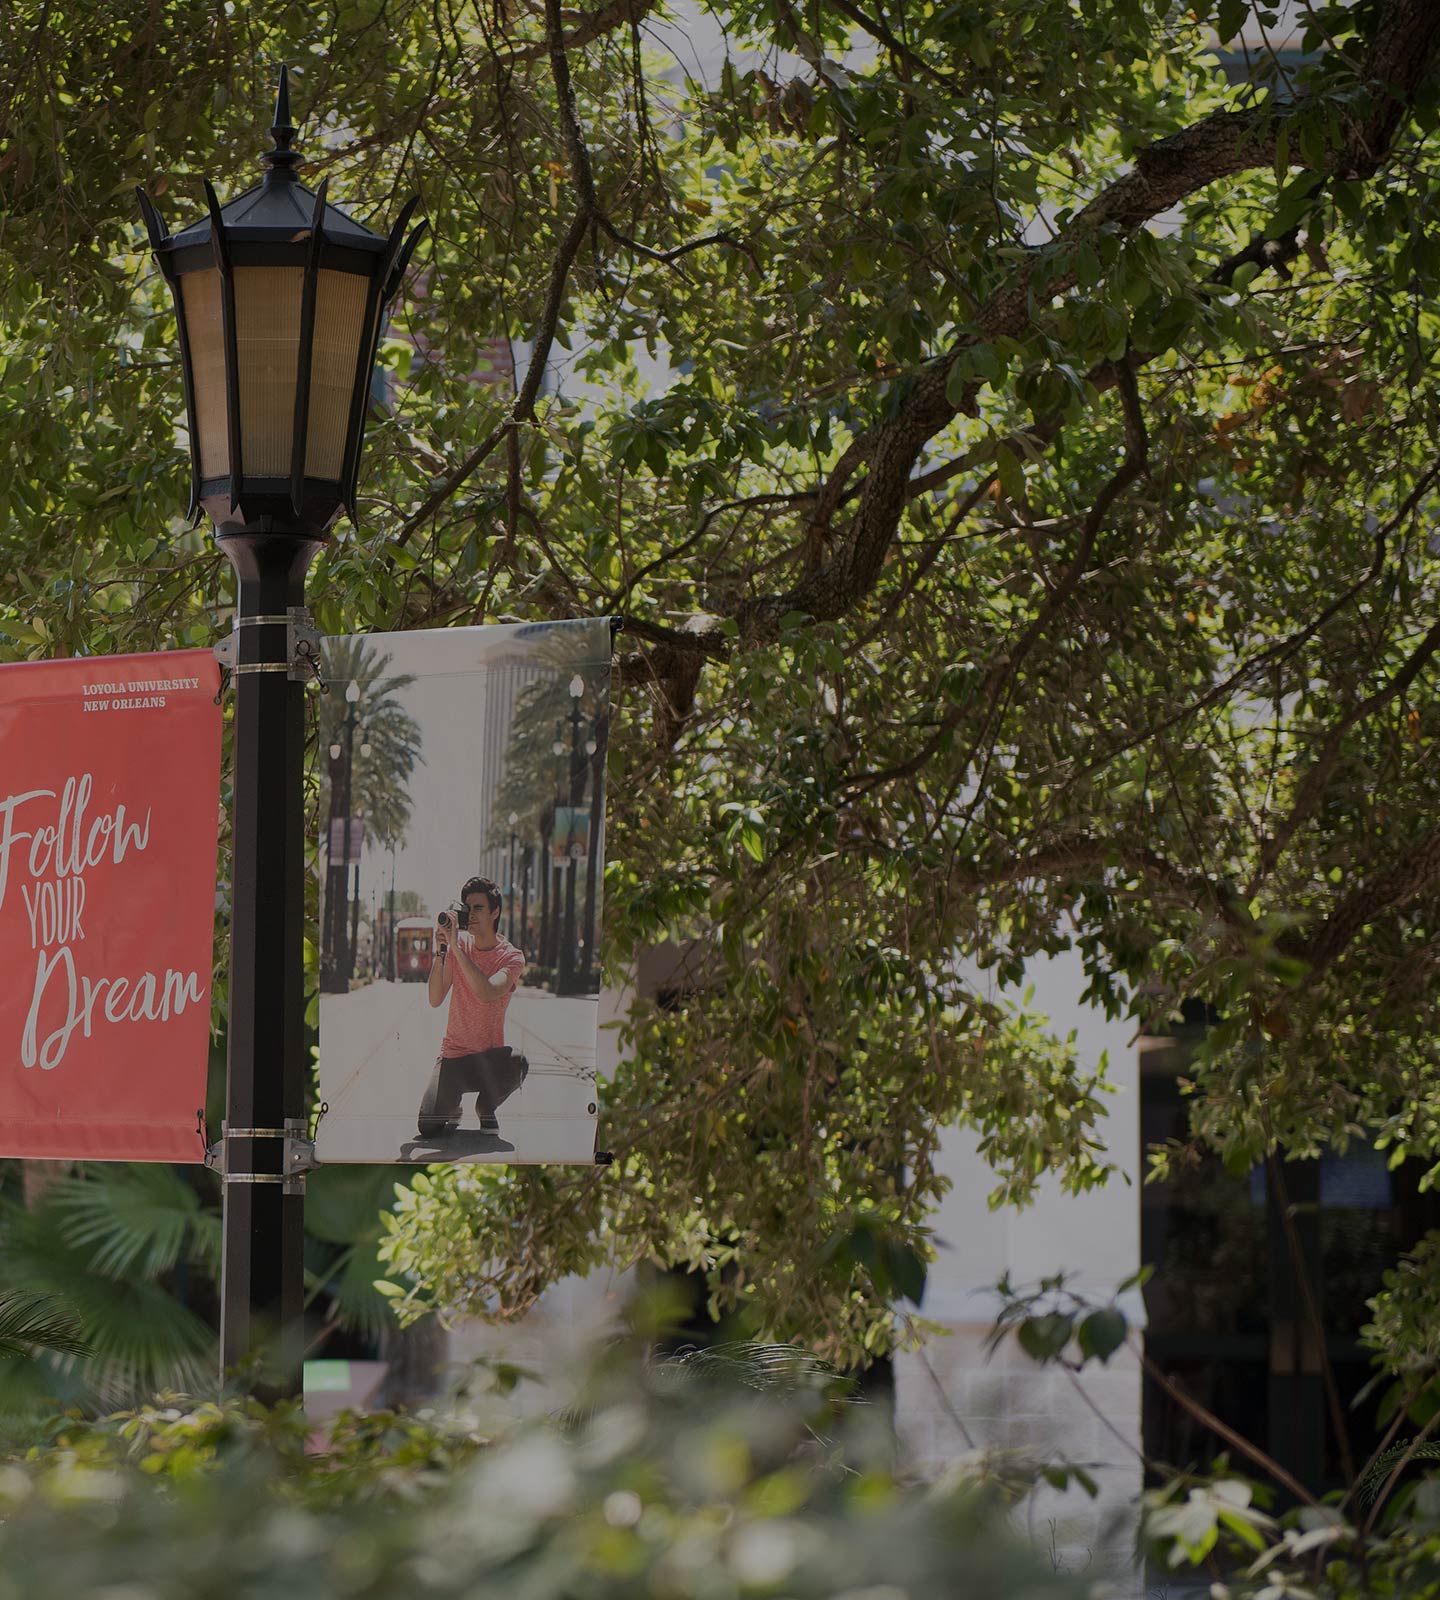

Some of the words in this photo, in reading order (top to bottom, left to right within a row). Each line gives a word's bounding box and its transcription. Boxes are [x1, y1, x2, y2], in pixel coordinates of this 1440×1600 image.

[82, 683, 127, 696] LOYOLA
[127, 678, 199, 693] UNIVERSITY
[83, 700, 110, 712] NEW
[112, 697, 166, 710] ORLEANS
[21, 875, 86, 949] YOUR
[21, 946, 206, 1071] Dream
